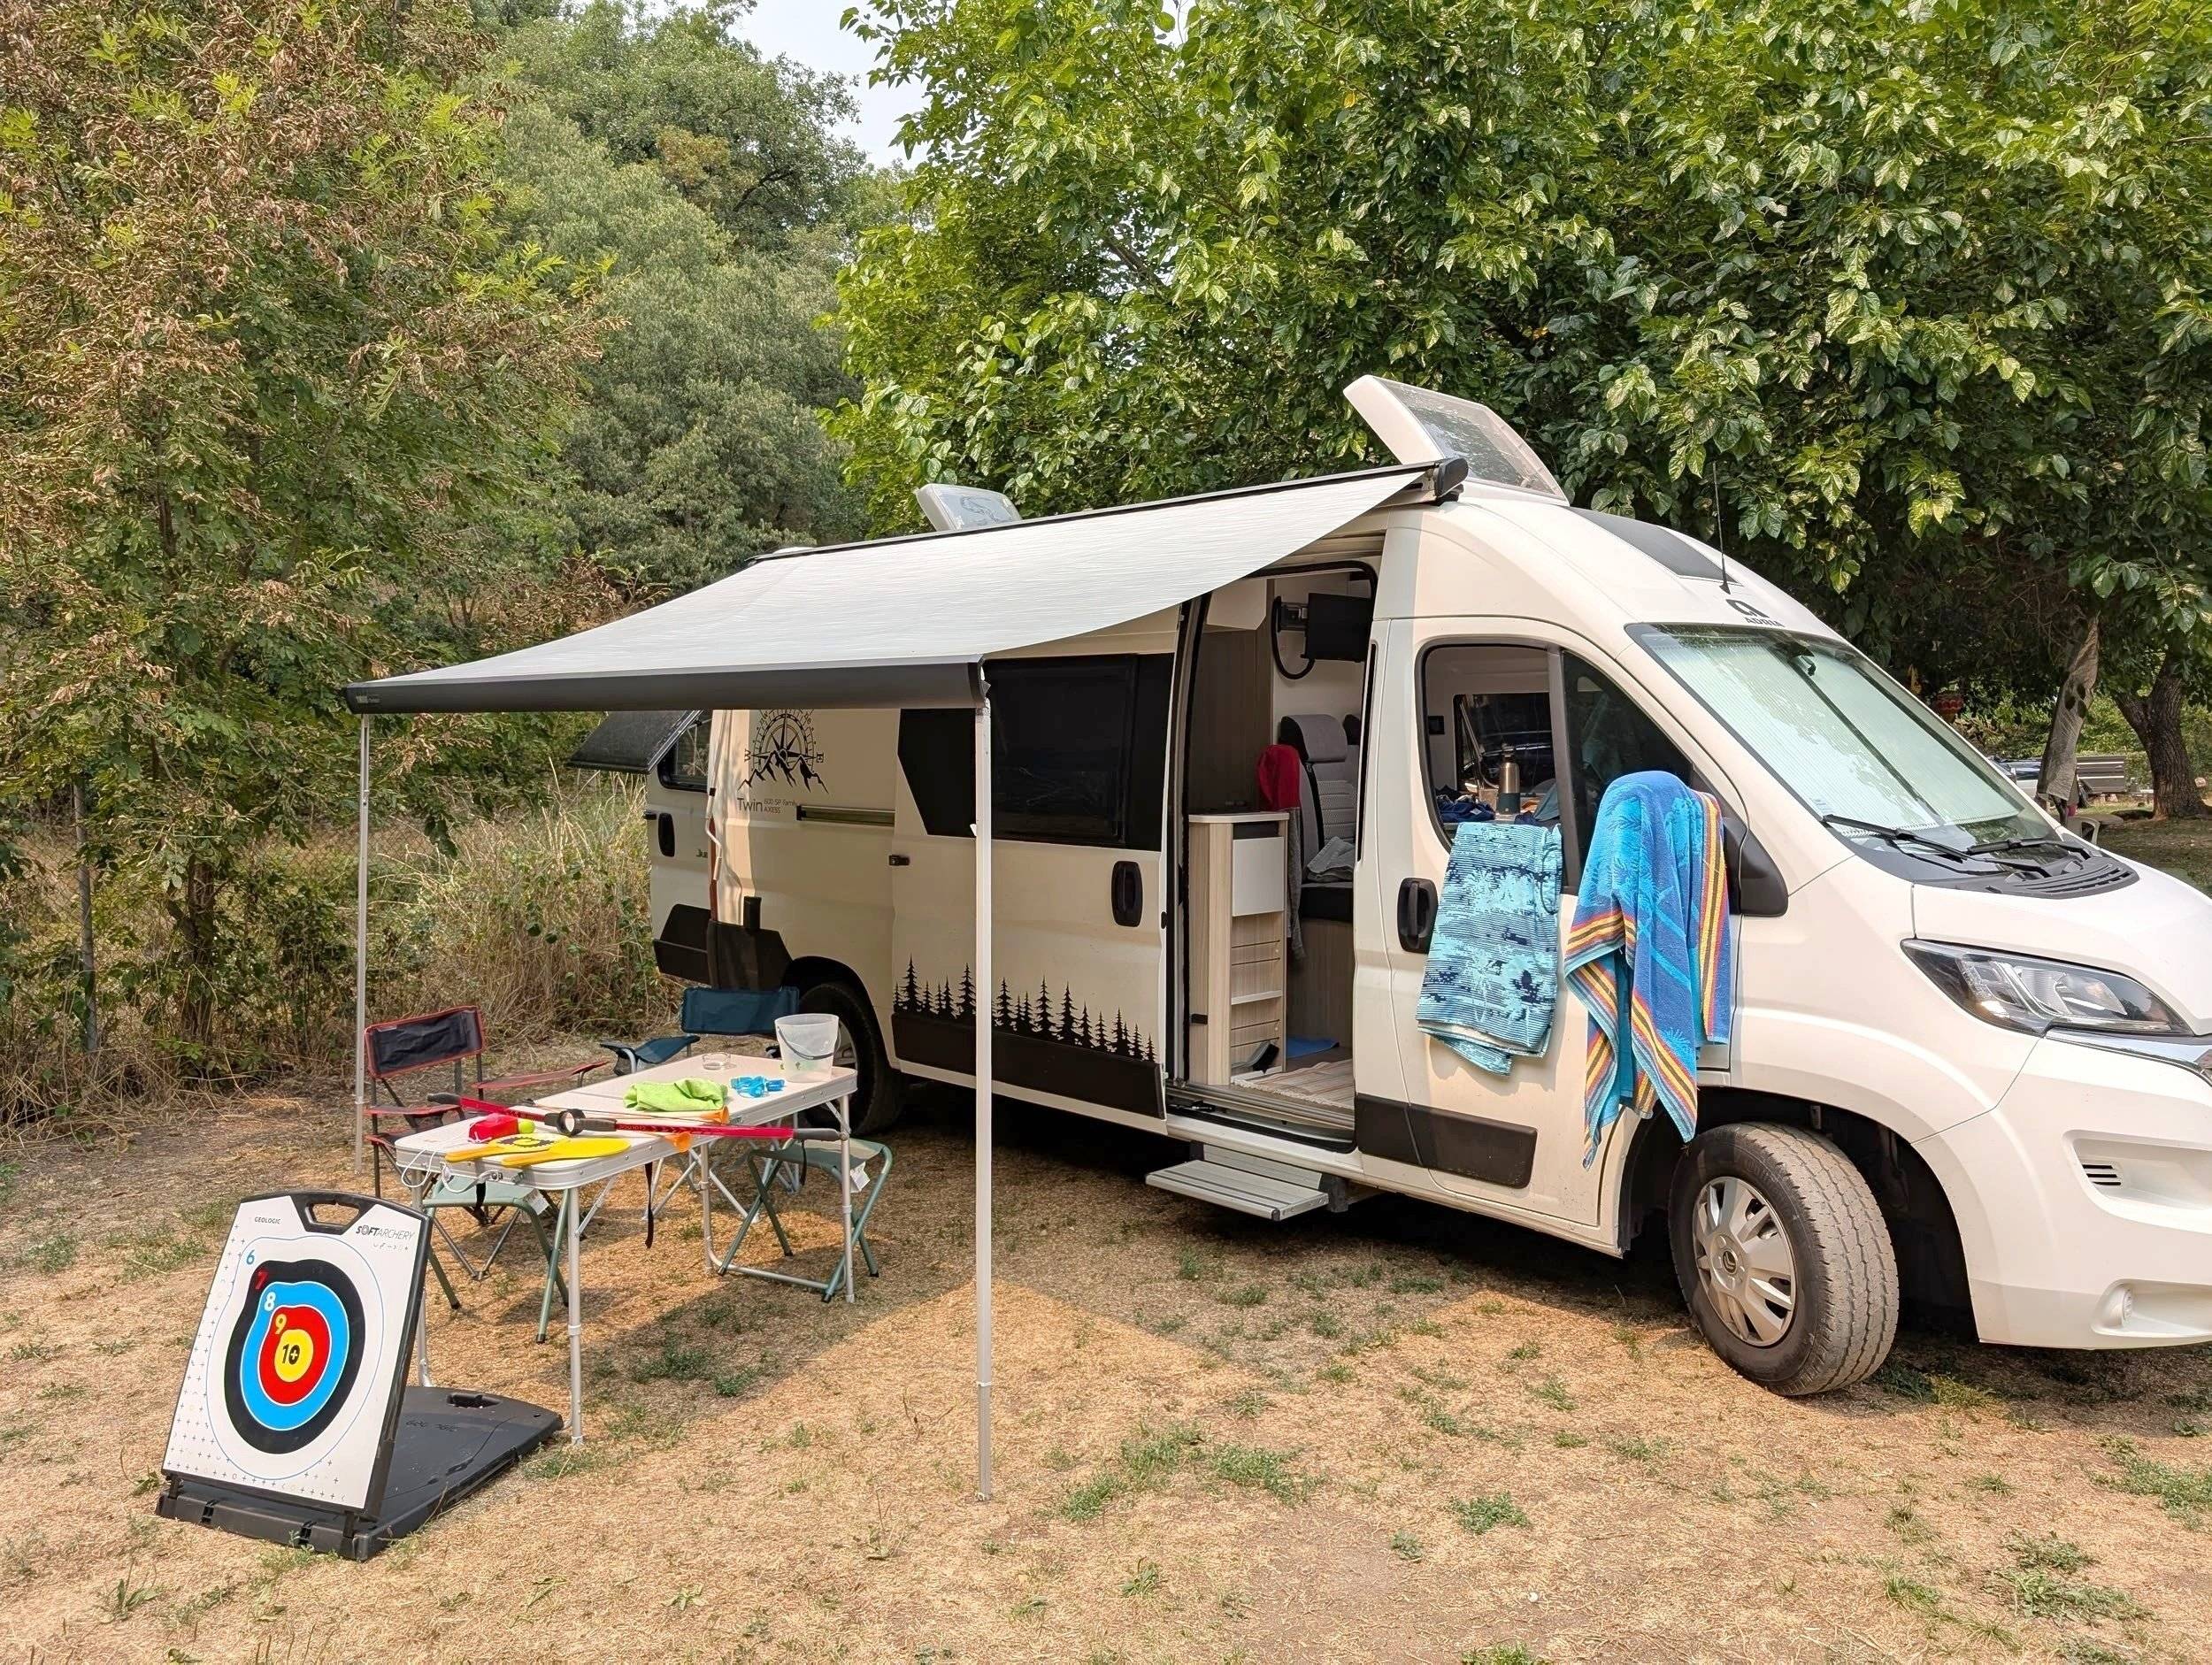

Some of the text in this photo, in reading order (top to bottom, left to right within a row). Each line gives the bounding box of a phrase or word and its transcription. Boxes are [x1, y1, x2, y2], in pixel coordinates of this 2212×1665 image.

[1743, 617, 1786, 627] ADRIA
[736, 797, 764, 813] Twin
[356, 1224, 416, 1240] SOFTARCHERY
[246, 1249, 256, 1265] 6
[255, 1271, 268, 1290] 7
[265, 1291, 276, 1311] 8
[275, 1313, 288, 1335] 9
[281, 1343, 301, 1365] 10
